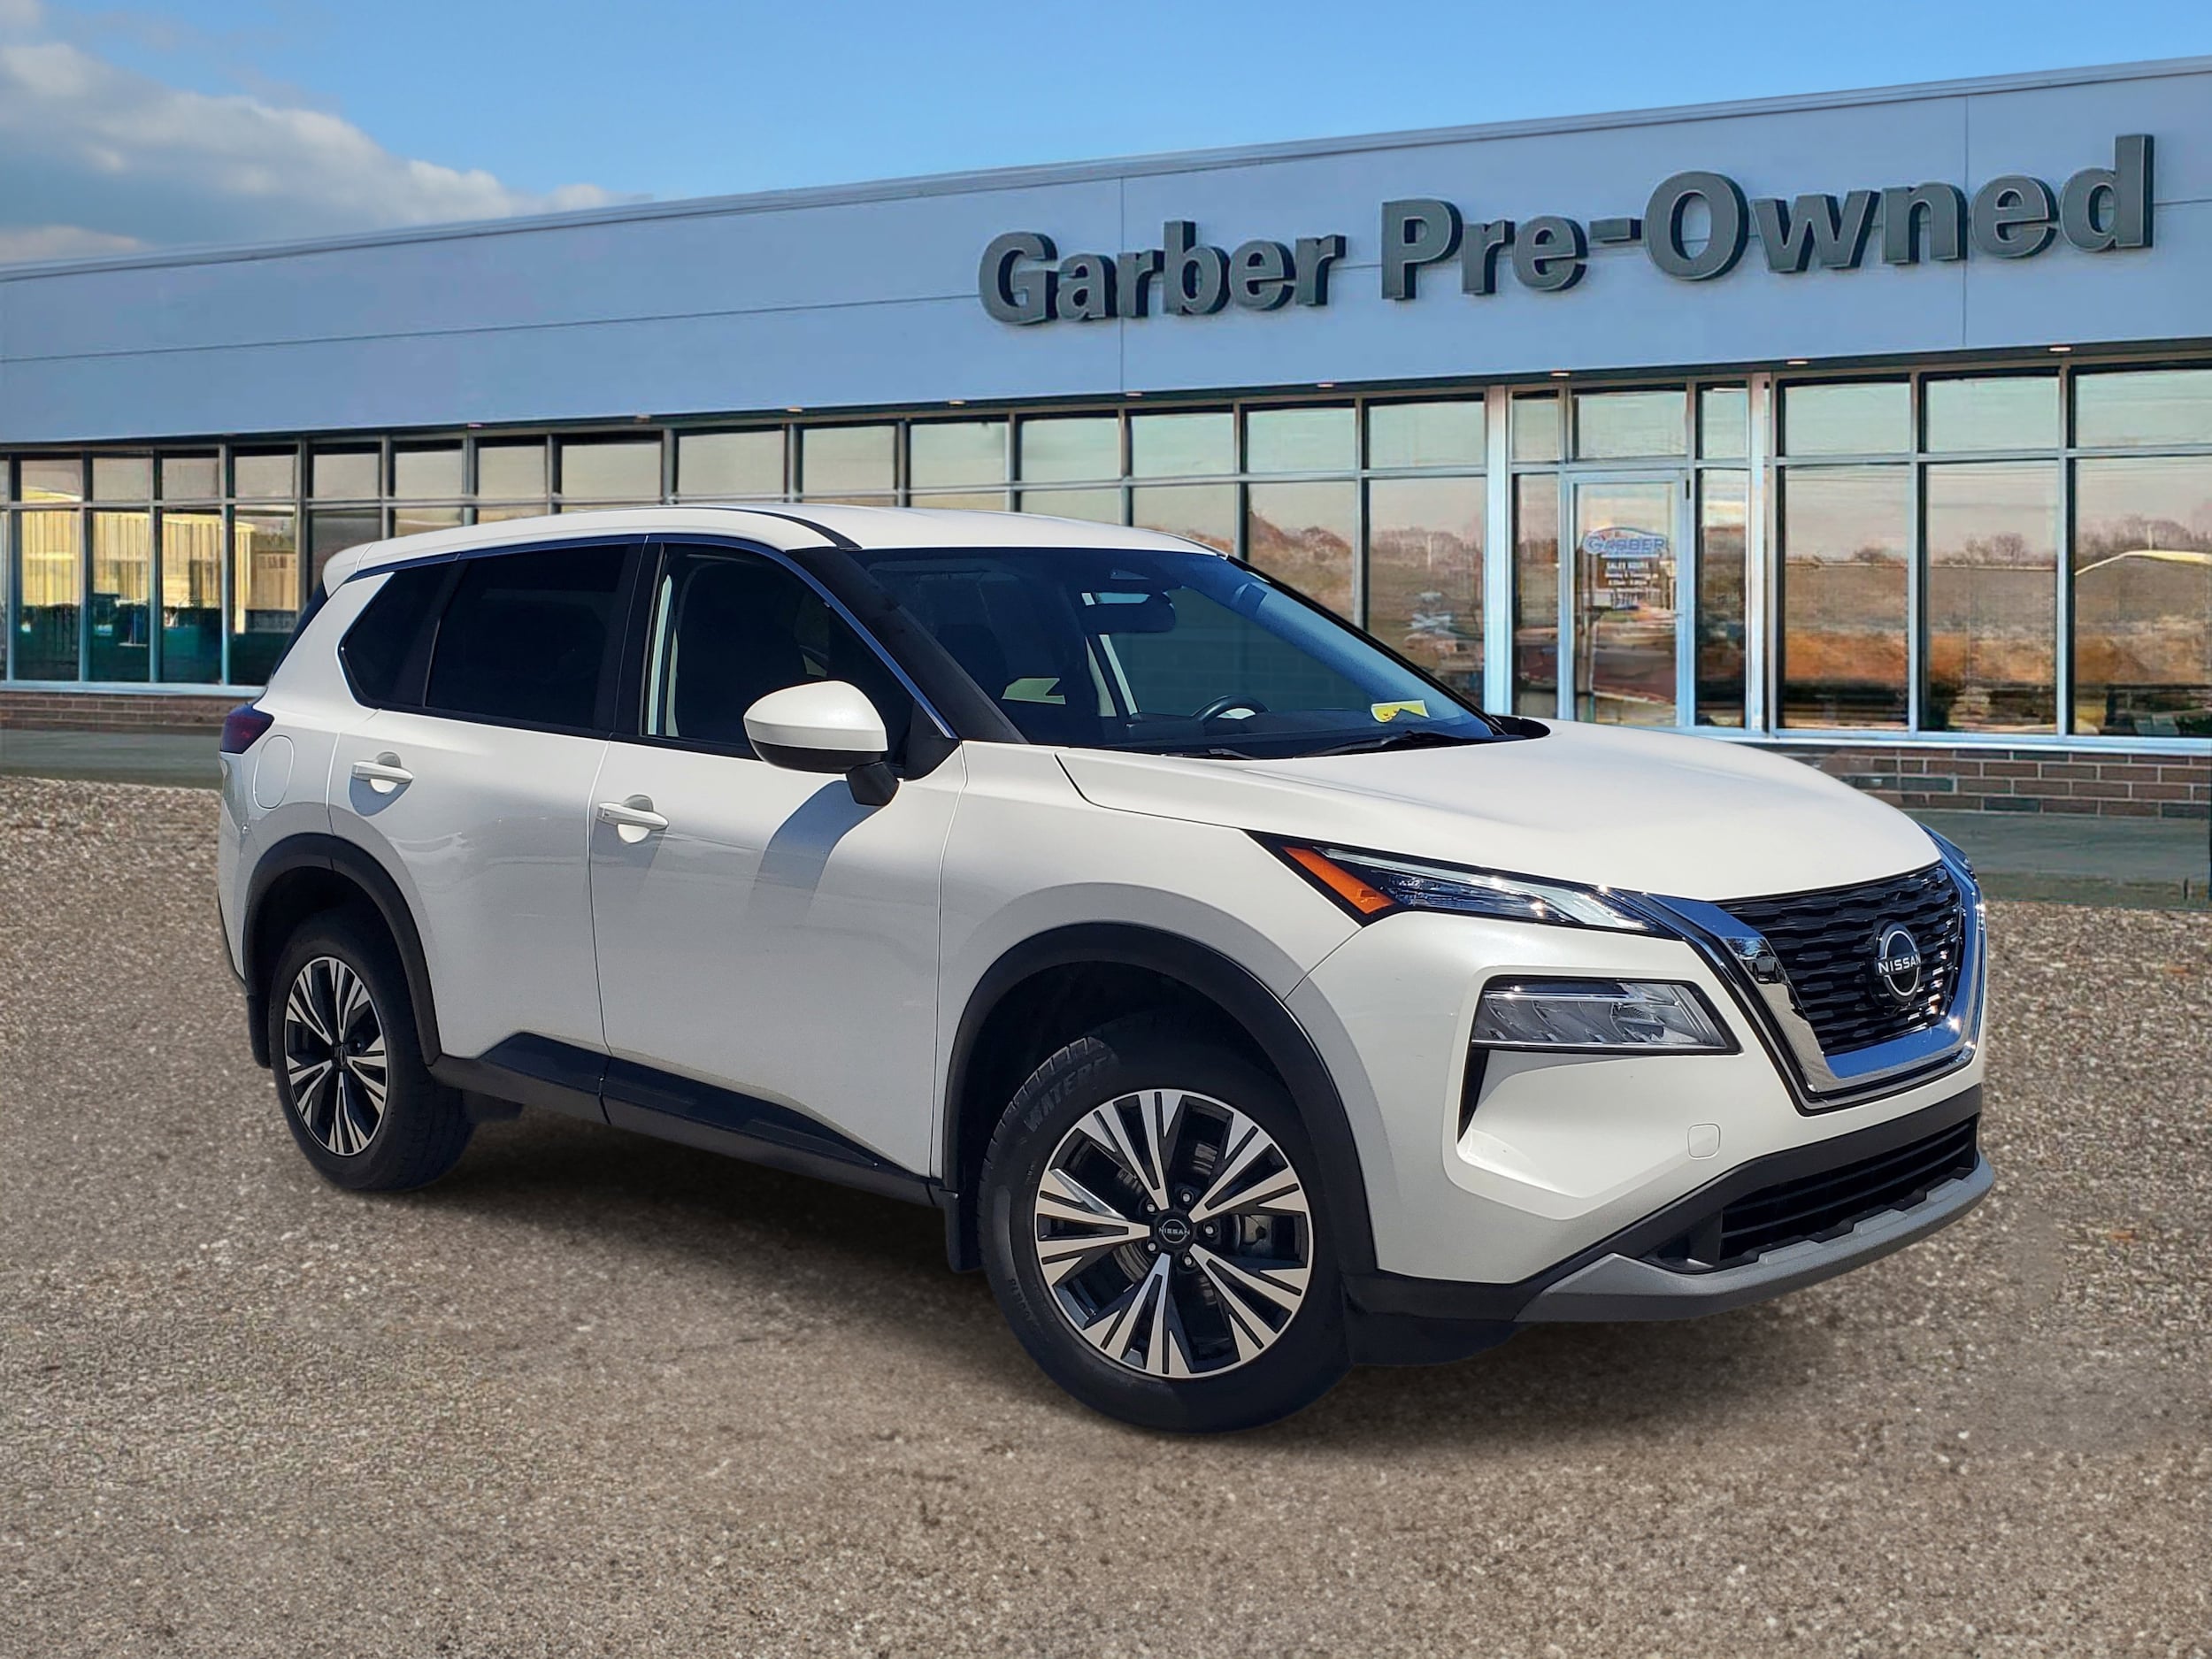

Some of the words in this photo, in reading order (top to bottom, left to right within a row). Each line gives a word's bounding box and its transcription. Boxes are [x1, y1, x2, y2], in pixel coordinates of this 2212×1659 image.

[979, 219, 1347, 325] Garber
[1381, 134, 2154, 301] Pre-Owned
[1878, 953, 1922, 973] NISSAN
[1158, 1226, 1191, 1235] NISSAN
